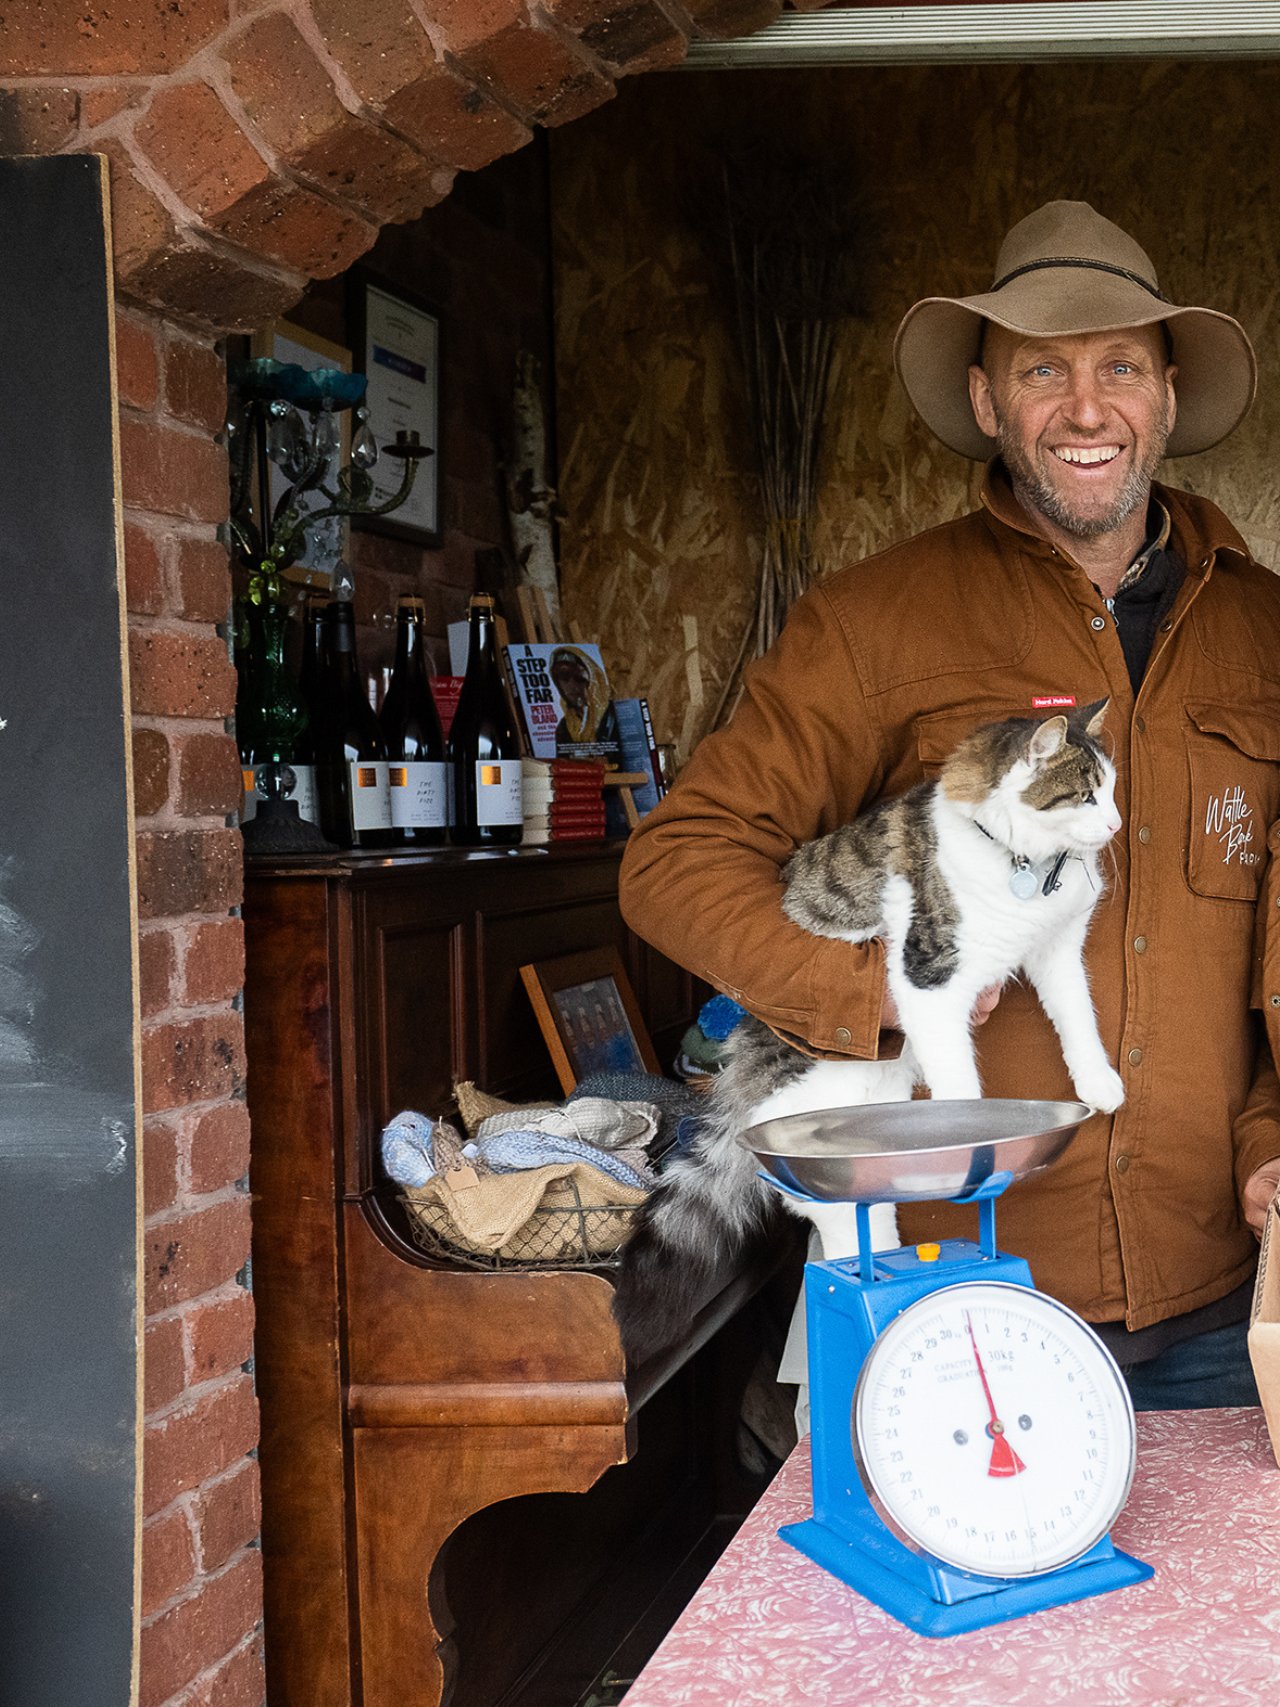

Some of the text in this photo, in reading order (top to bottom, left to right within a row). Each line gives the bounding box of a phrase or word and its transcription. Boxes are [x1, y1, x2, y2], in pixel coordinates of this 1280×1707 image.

[524, 645, 533, 657] A
[517, 659, 546, 673] STEP
[521, 674, 550, 688] TOO
[526, 689, 554, 704] FAR
[530, 705, 554, 716] PETER
[1205, 785, 1253, 835] Wattle
[984, 1323, 990, 1334] 1
[1003, 1327, 1011, 1338] 2
[939, 1329, 953, 1341] 30
[1020, 1332, 1028, 1343] 3
[924, 1337, 938, 1349] 29
[910, 1350, 924, 1362] 28
[934, 1349, 1015, 1372] CAPACITY 30kg
[1053, 1353, 1061, 1365] 5
[900, 1367, 912, 1379] 27
[1067, 1372, 1075, 1383] 6
[892, 1386, 906, 1398] 26
[1077, 1391, 1084, 1402] 7
[887, 1405, 901, 1417] 25
[1086, 1409, 1094, 1420] 8
[885, 1427, 899, 1440] 24
[1089, 1429, 1097, 1440] 9
[890, 1450, 904, 1463] 23
[1086, 1448, 1098, 1460] 10
[899, 1471, 913, 1483] 22
[1082, 1469, 1094, 1481] 11
[911, 1488, 923, 1500] 21
[1074, 1489, 1086, 1501] 12
[927, 1505, 941, 1517] 20
[1059, 1505, 1072, 1518] 13
[945, 1517, 959, 1529] 19
[965, 1526, 978, 1539] 18
[984, 1530, 996, 1543] 17
[1005, 1530, 1018, 1542] 16
[1025, 1527, 1037, 1539] 15
